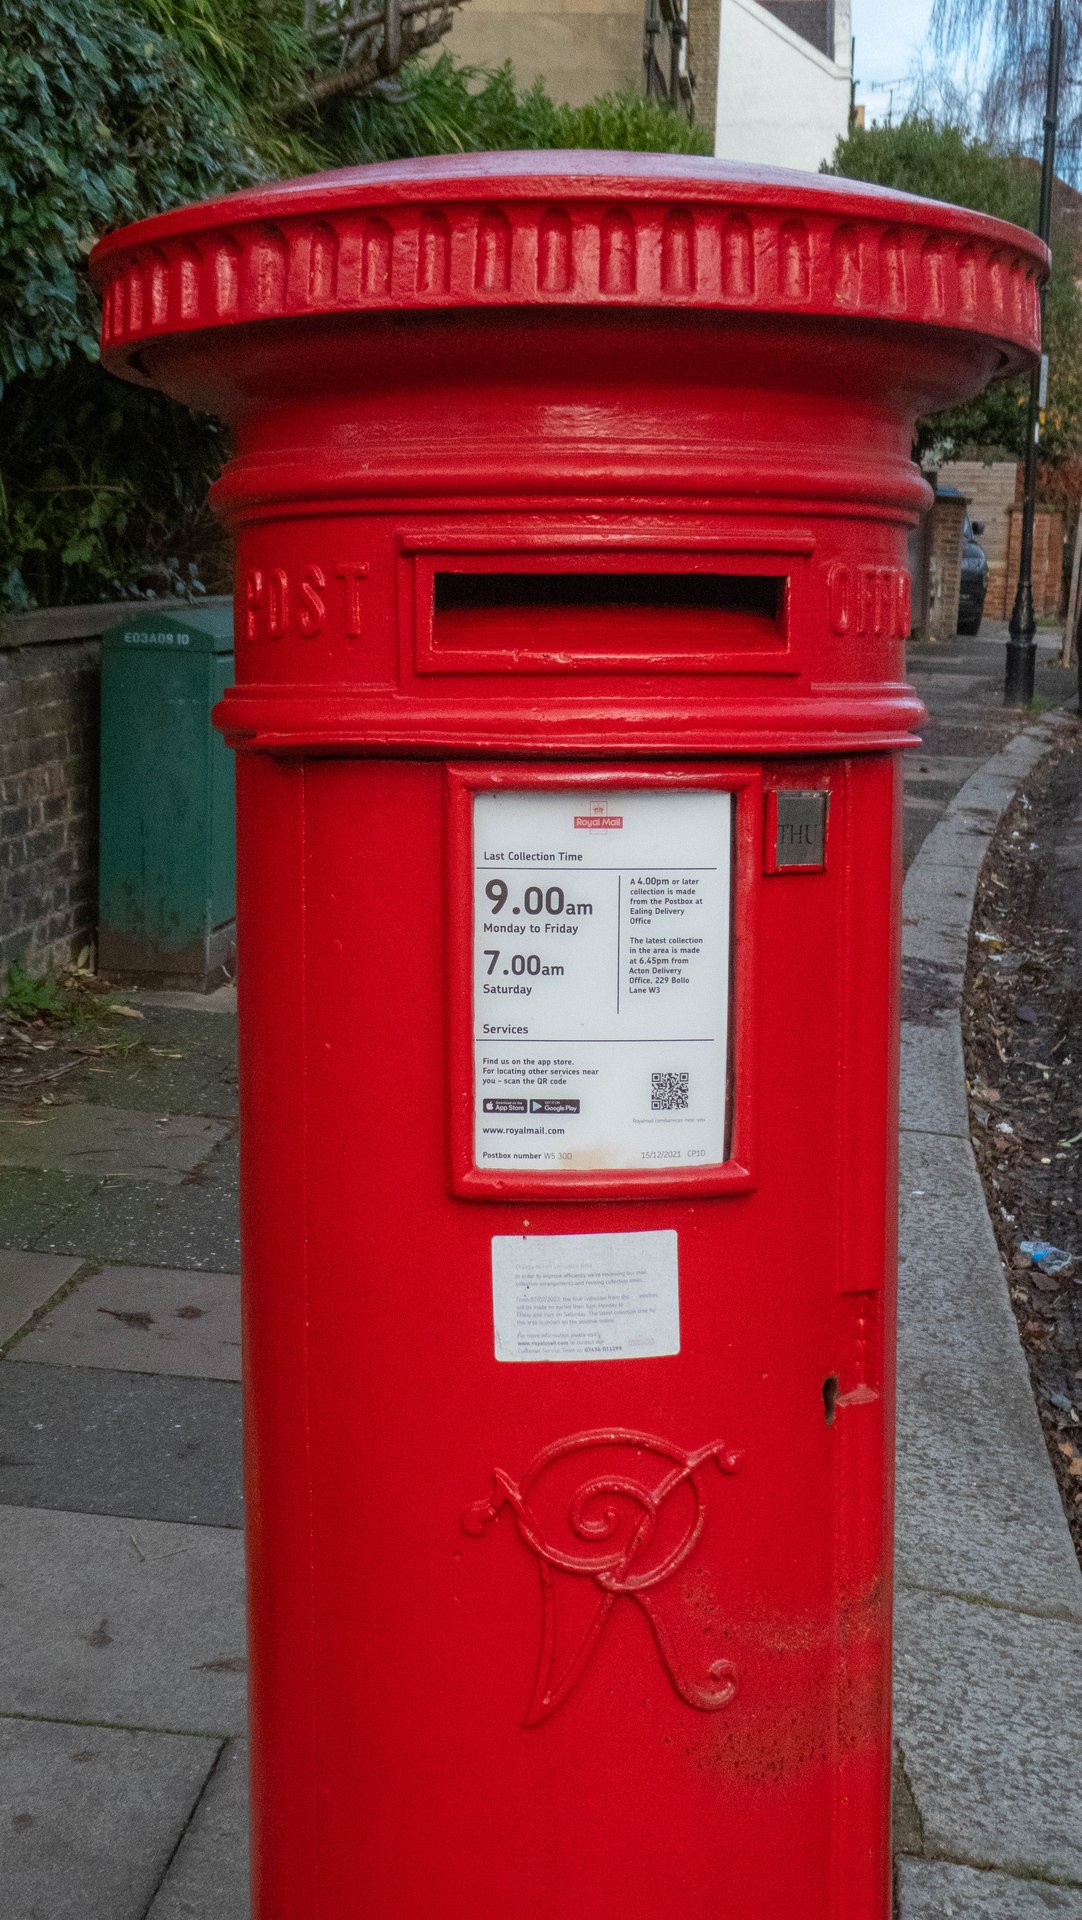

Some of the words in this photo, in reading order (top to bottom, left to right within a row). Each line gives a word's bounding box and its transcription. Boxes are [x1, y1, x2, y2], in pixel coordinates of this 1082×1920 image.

[247, 562, 370, 640] POST
[576, 818, 600, 828] Royal
[602, 818, 620, 826] Mail
[779, 823, 818, 844] THU
[484, 851, 504, 860] Last
[508, 852, 555, 861] Collection
[558, 852, 582, 861] Time
[638, 877, 669, 886] 4.00pm
[485, 879, 592, 915] 9.00am
[630, 908, 652, 916] Ealing
[655, 908, 684, 916] Delivery
[484, 923, 526, 935] Monday
[529, 924, 540, 933] to
[545, 924, 578, 935] Friday
[484, 950, 564, 975] 7.00am
[639, 957, 669, 965] 6.45pm
[652, 967, 681, 975] Delivery
[483, 984, 532, 996] Saturday
[483, 1024, 528, 1034] Services
[497, 1068, 526, 1076] locating
[550, 1068, 579, 1076] services
[483, 1127, 564, 1135] www.royalmail.com
[641, 1151, 680, 1159] 15/12/2021
